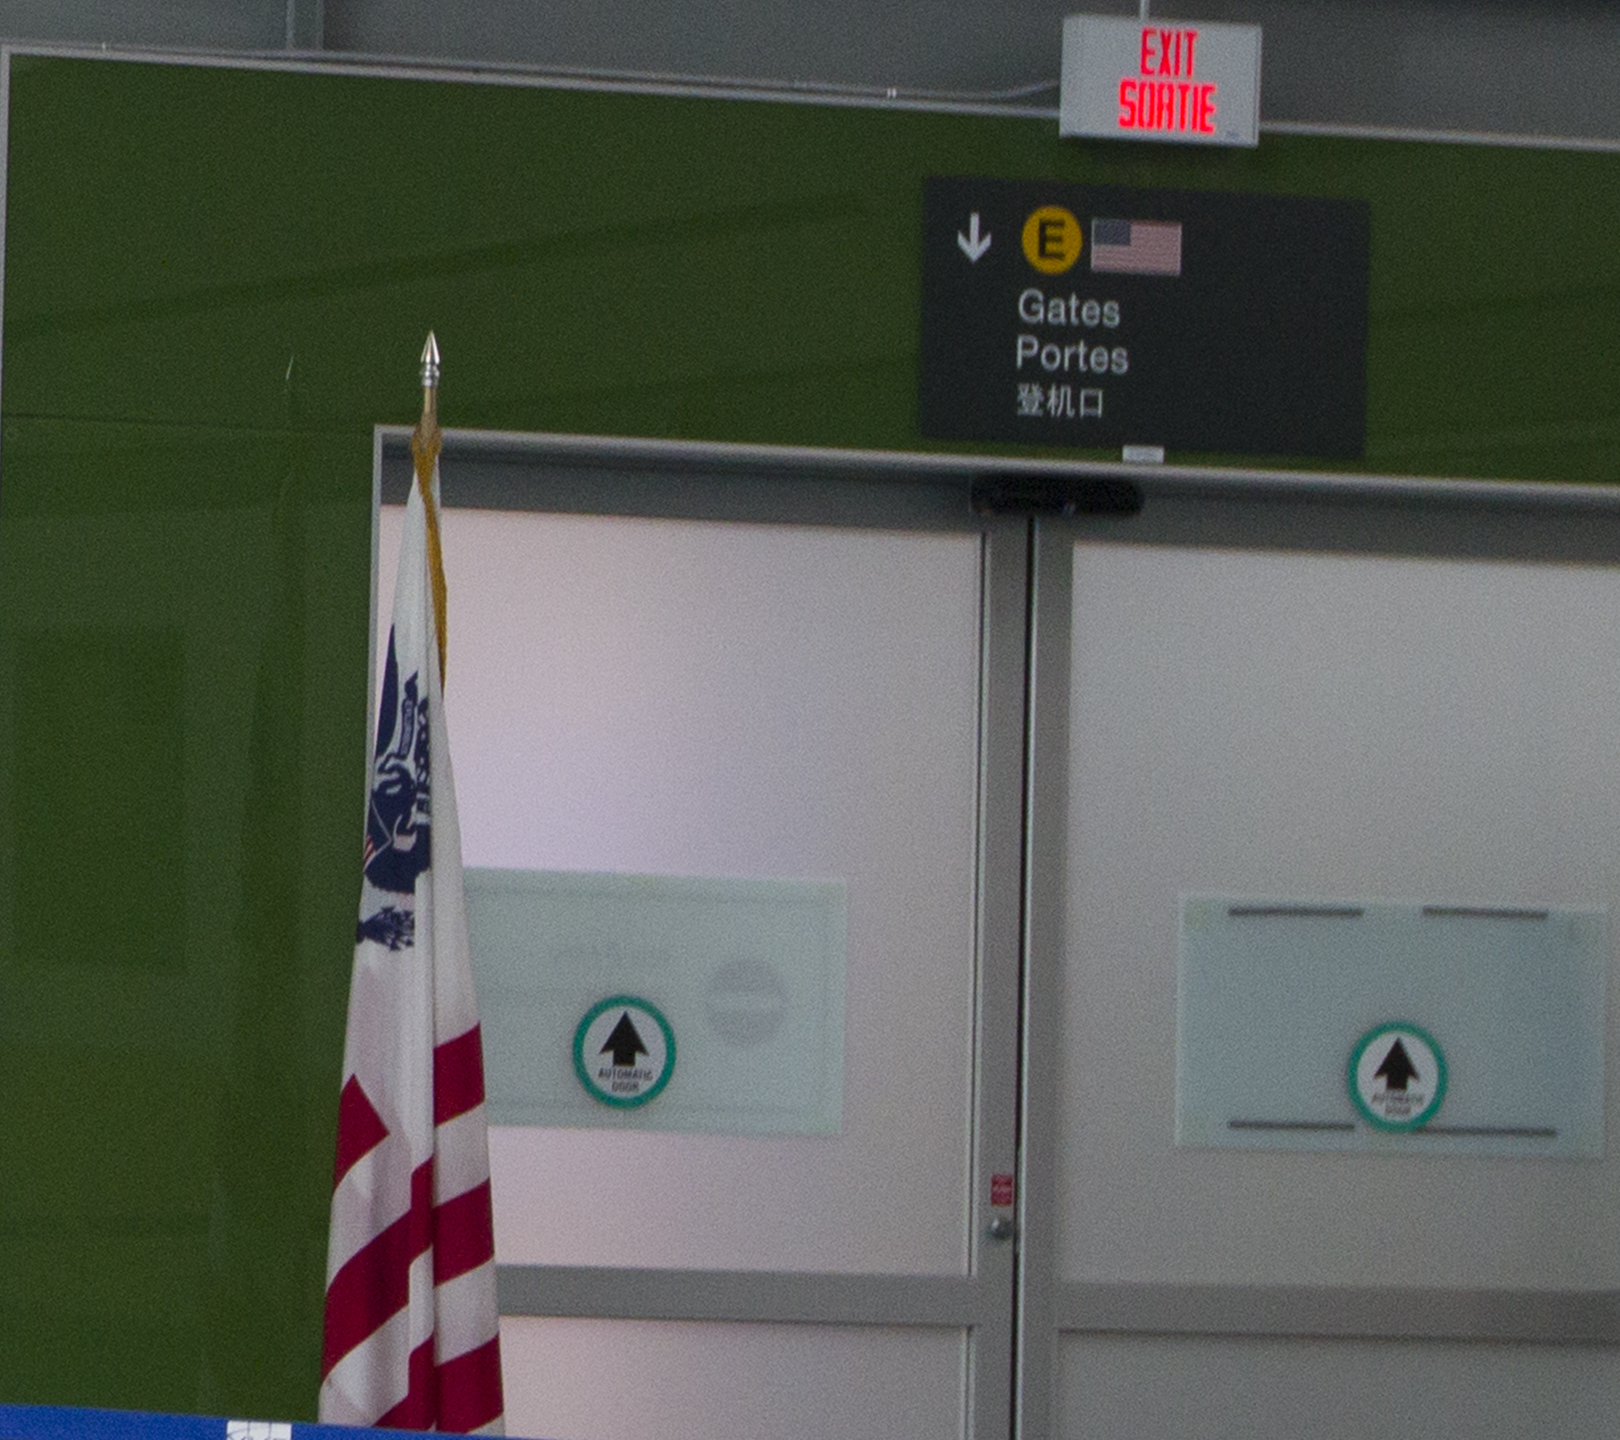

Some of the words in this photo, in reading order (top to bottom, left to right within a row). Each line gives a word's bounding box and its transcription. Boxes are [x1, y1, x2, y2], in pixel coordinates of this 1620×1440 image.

[1140, 27, 1198, 78] EXIT
[1118, 78, 1217, 134] SORTIE
[1039, 218, 1066, 261] E
[1018, 288, 1121, 329] Gates
[1016, 334, 1129, 375] Portes
[1016, 383, 1104, 419] 登机口
[598, 1067, 654, 1081] AUTOMATIC
[612, 1081, 640, 1093] DOOR
